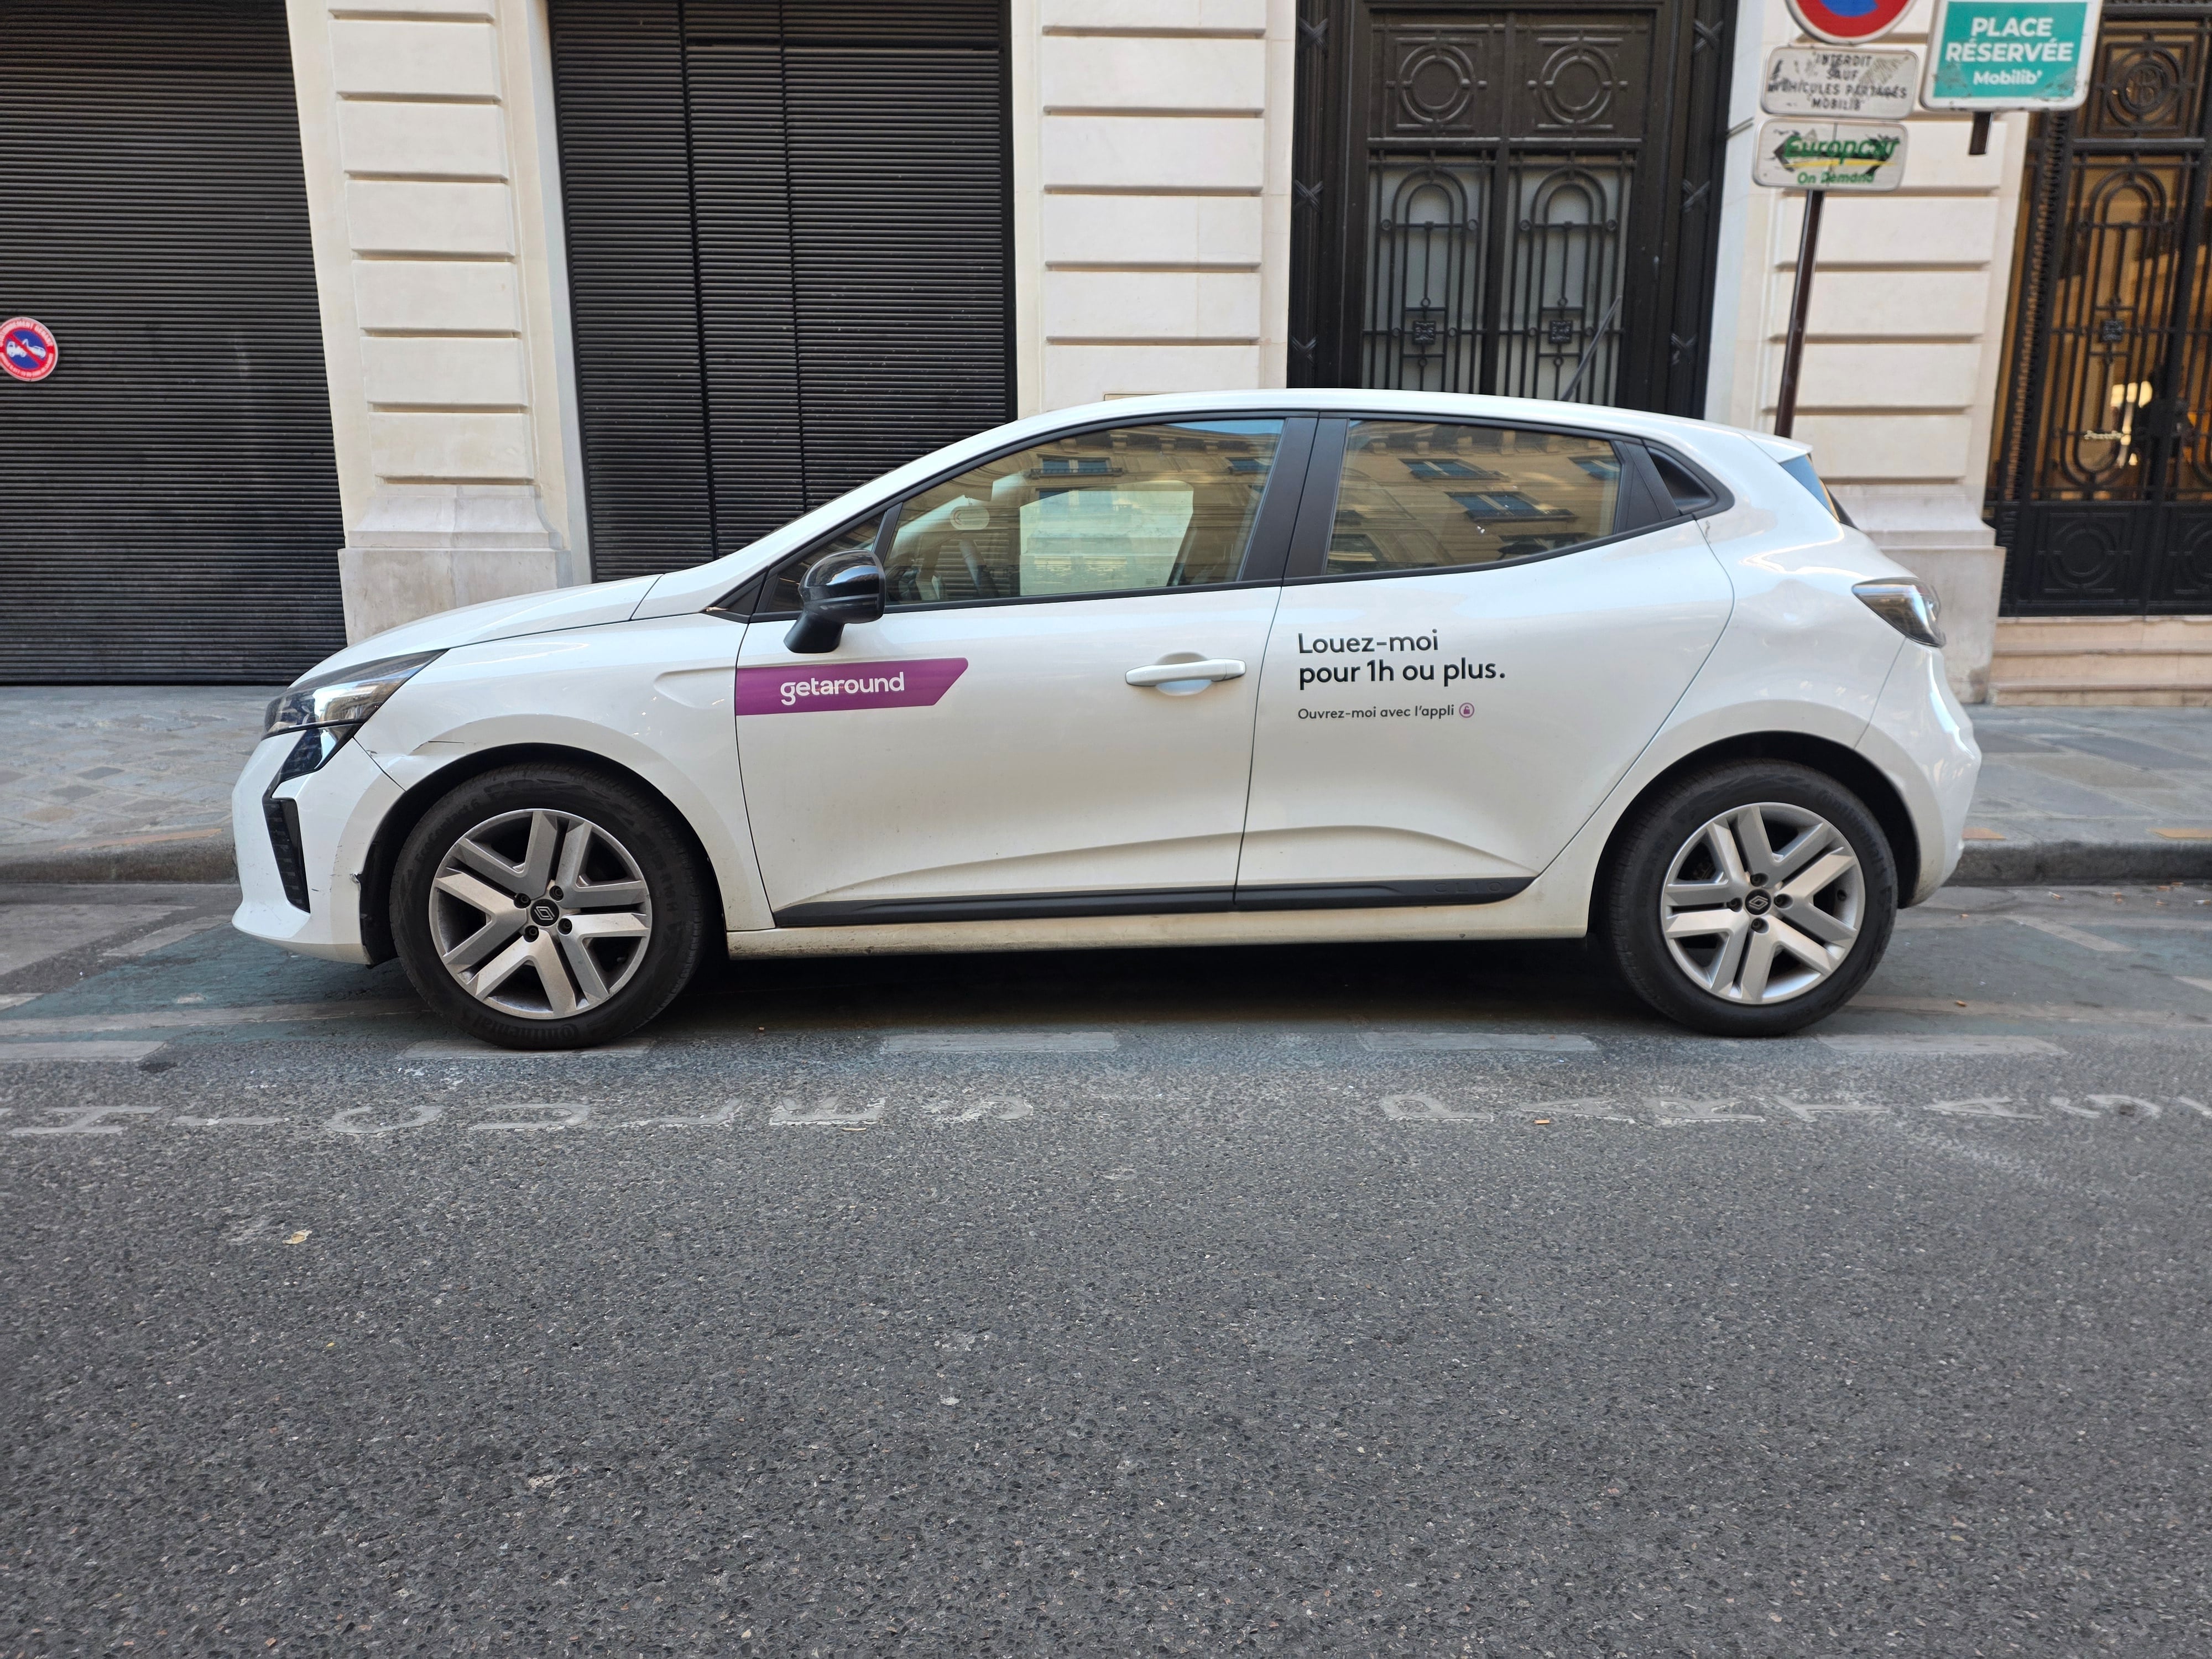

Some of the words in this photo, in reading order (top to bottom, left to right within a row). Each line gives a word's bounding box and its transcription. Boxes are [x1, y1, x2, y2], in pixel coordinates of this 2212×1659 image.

[1970, 17, 2054, 37] PLACE
[1945, 37, 2074, 62] RÉSERVÉE
[1815, 54, 1872, 67] INTERDIT
[1827, 69, 1859, 81] SAUF
[1973, 69, 2043, 85] Mobilib'
[1783, 135, 1900, 165] Europcar
[1798, 171, 1817, 184] On
[1298, 628, 1438, 654] Louez-moi
[1300, 665, 1361, 691] pour
[1366, 659, 1394, 682] 1h
[1402, 664, 1434, 681] ou
[1444, 657, 1506, 687] plus.
[780, 671, 905, 706] getaround
[1298, 706, 1376, 719] Ouvrez-moi
[1380, 708, 1411, 718] avec
[1415, 705, 1454, 719] l'appli
